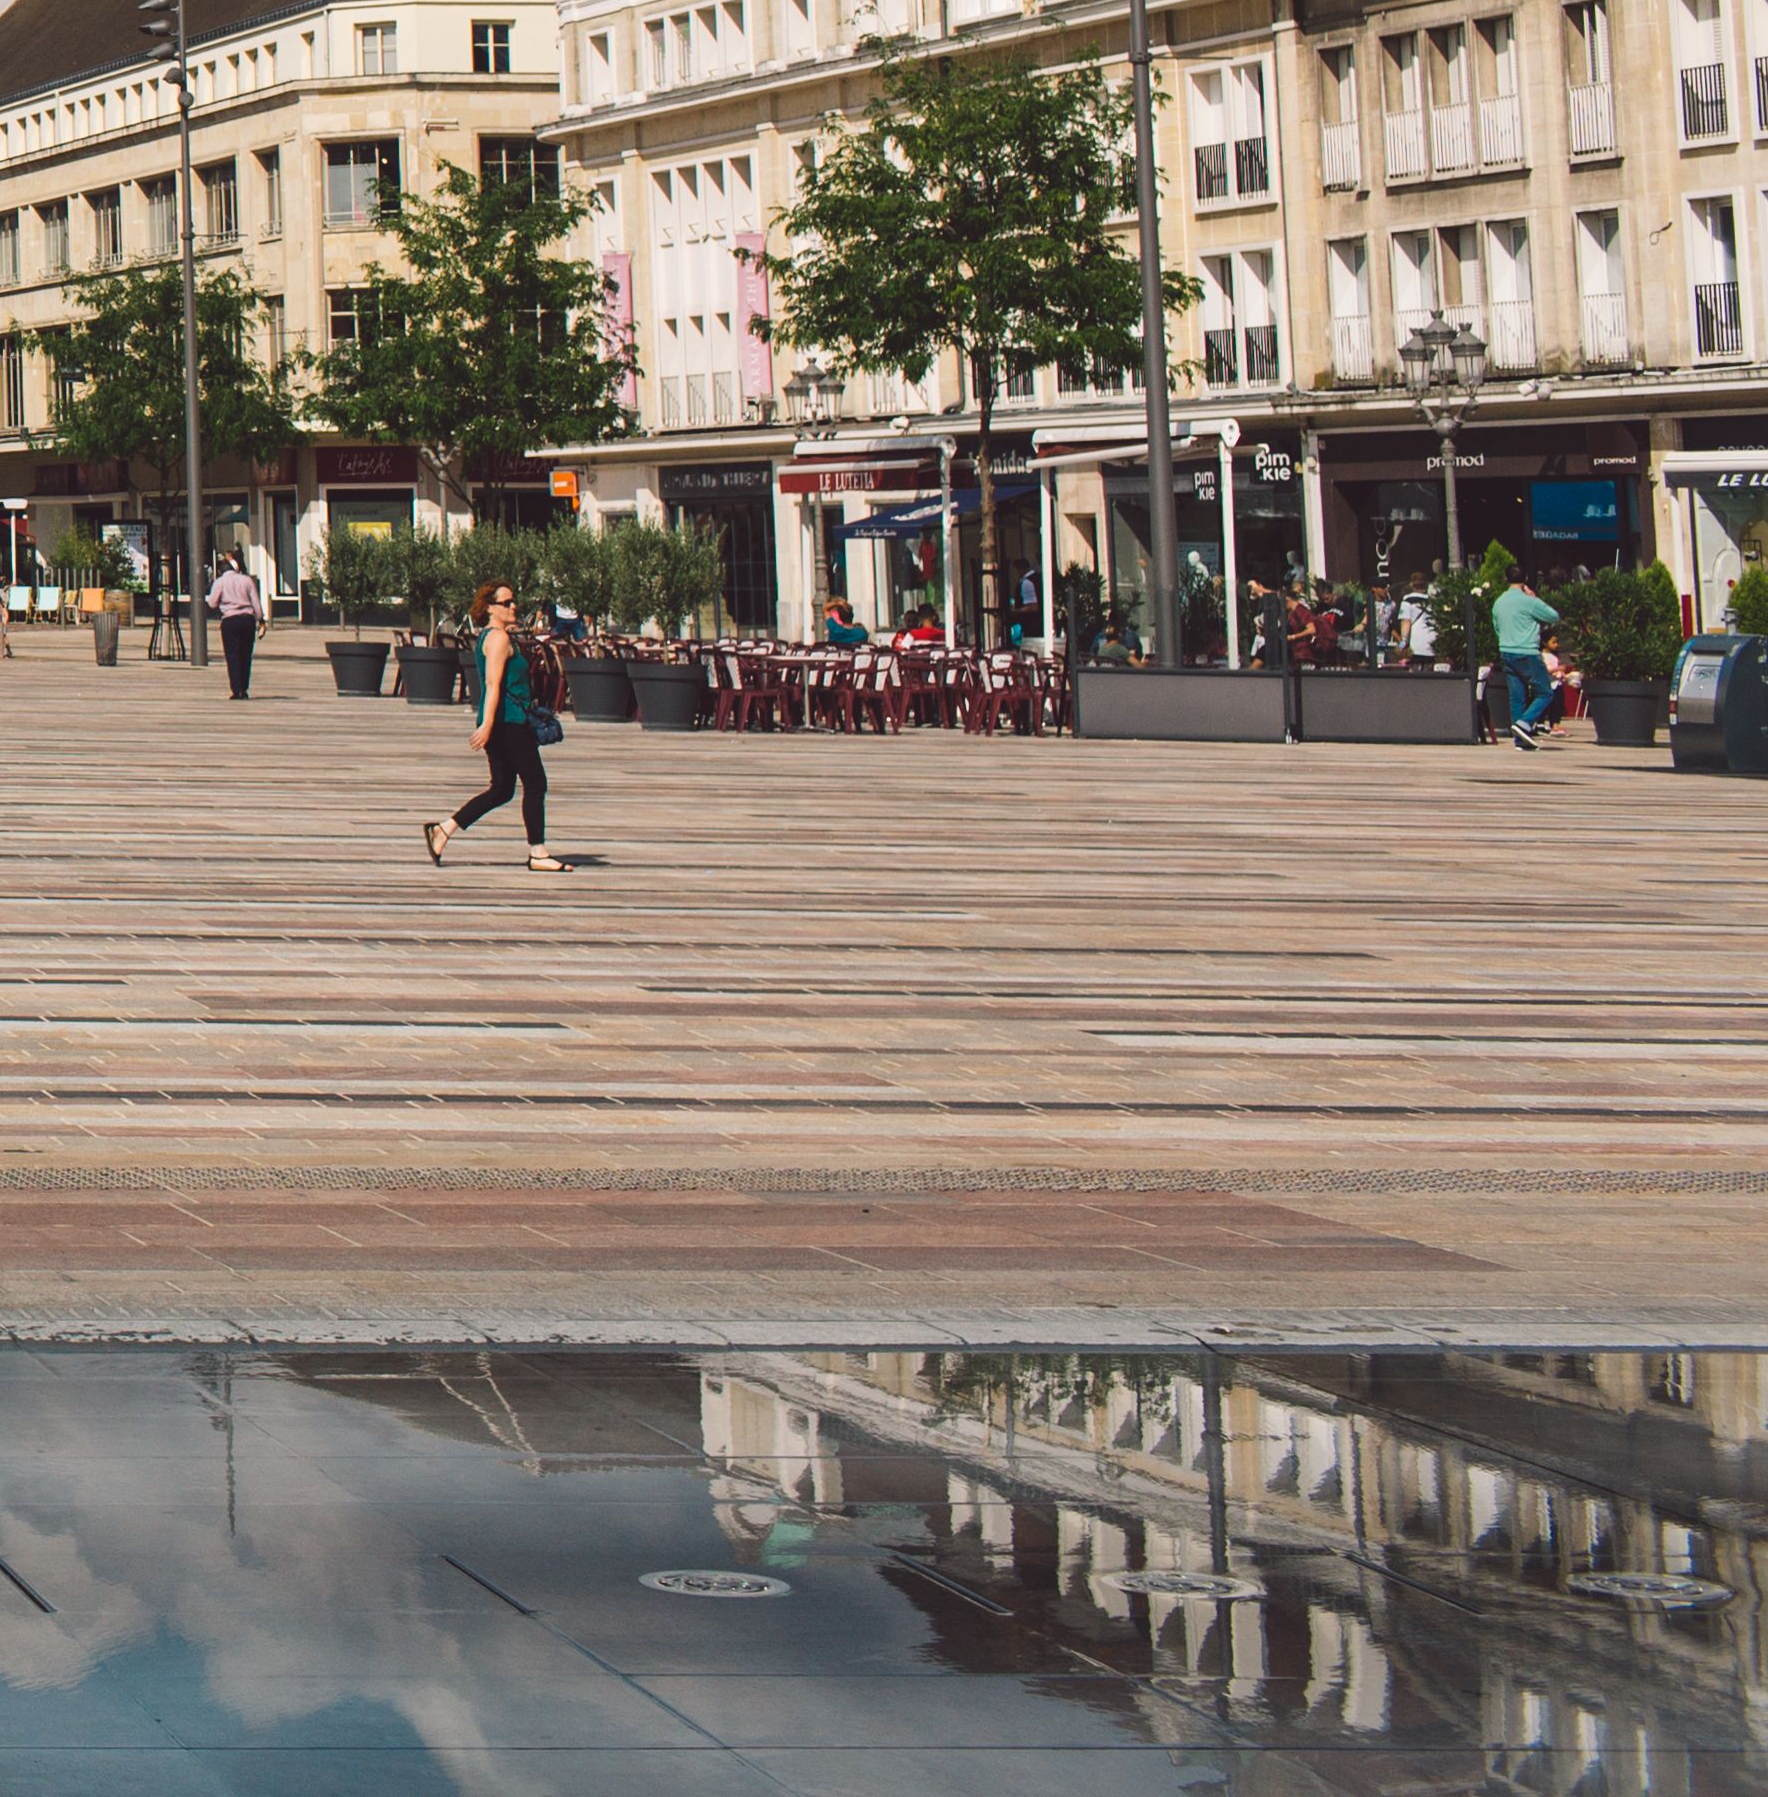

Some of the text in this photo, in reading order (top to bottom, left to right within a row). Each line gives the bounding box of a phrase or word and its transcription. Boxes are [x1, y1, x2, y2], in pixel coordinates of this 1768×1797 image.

[1594, 456, 1637, 465] promod
[819, 472, 875, 492] LE LUTETIA
[1194, 471, 1215, 490] pim
[1717, 473, 1743, 487] LE
